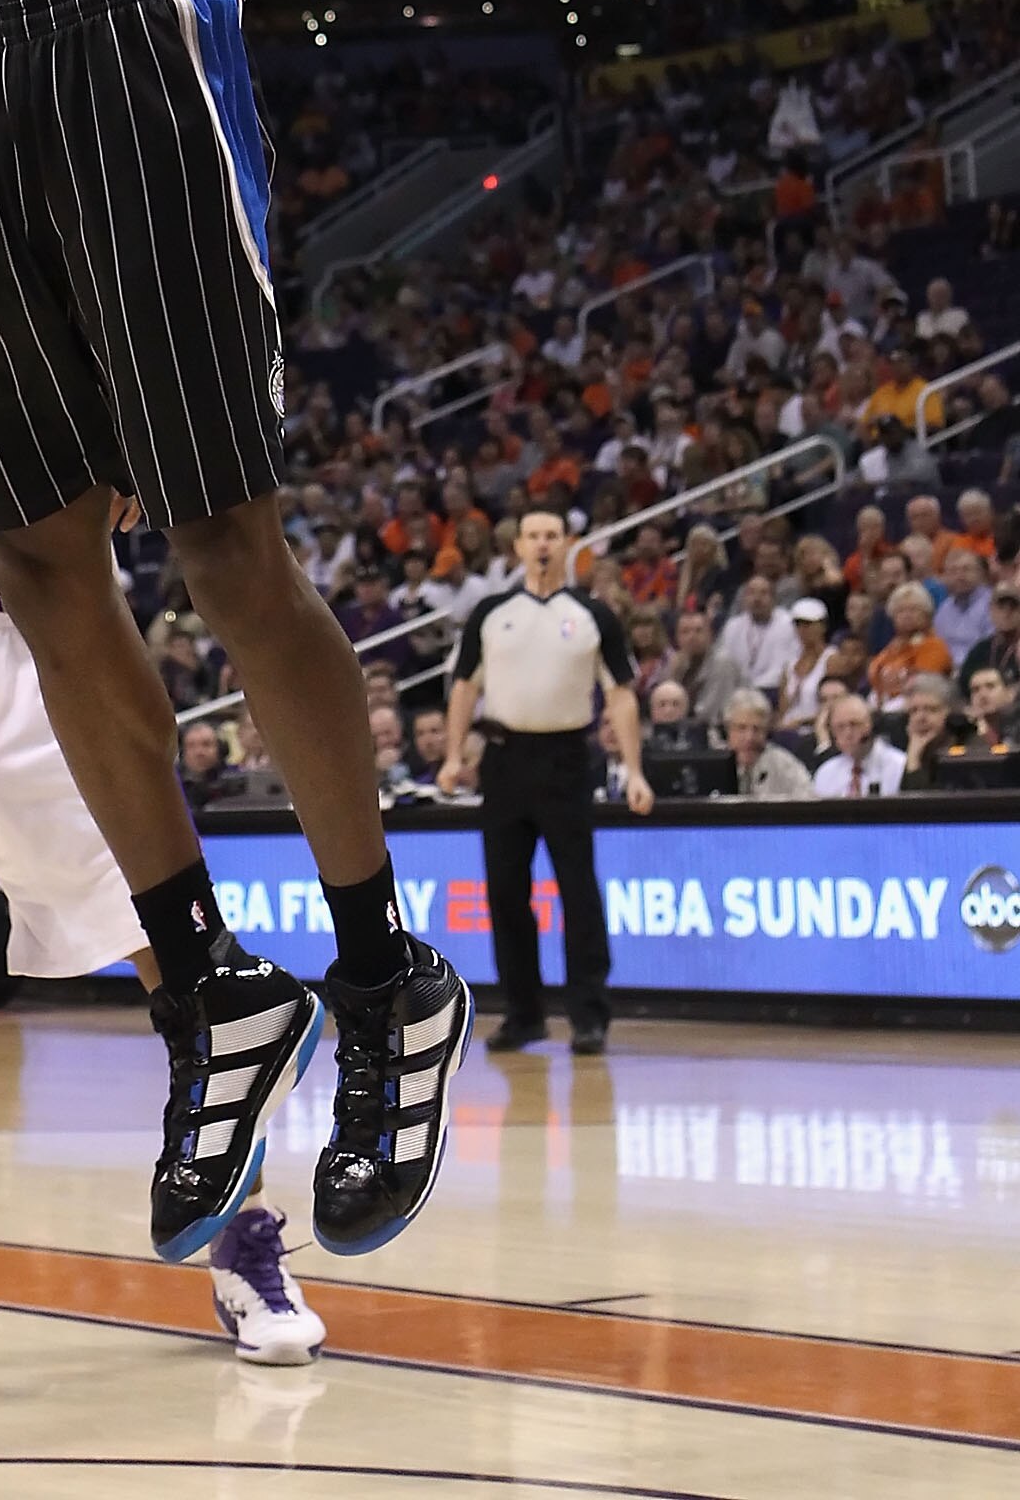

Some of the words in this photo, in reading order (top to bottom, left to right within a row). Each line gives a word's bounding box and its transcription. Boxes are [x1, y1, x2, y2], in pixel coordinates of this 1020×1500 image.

[214, 879, 276, 933] BA
[605, 878, 714, 937] NBA
[722, 876, 948, 940] SUNDAY
